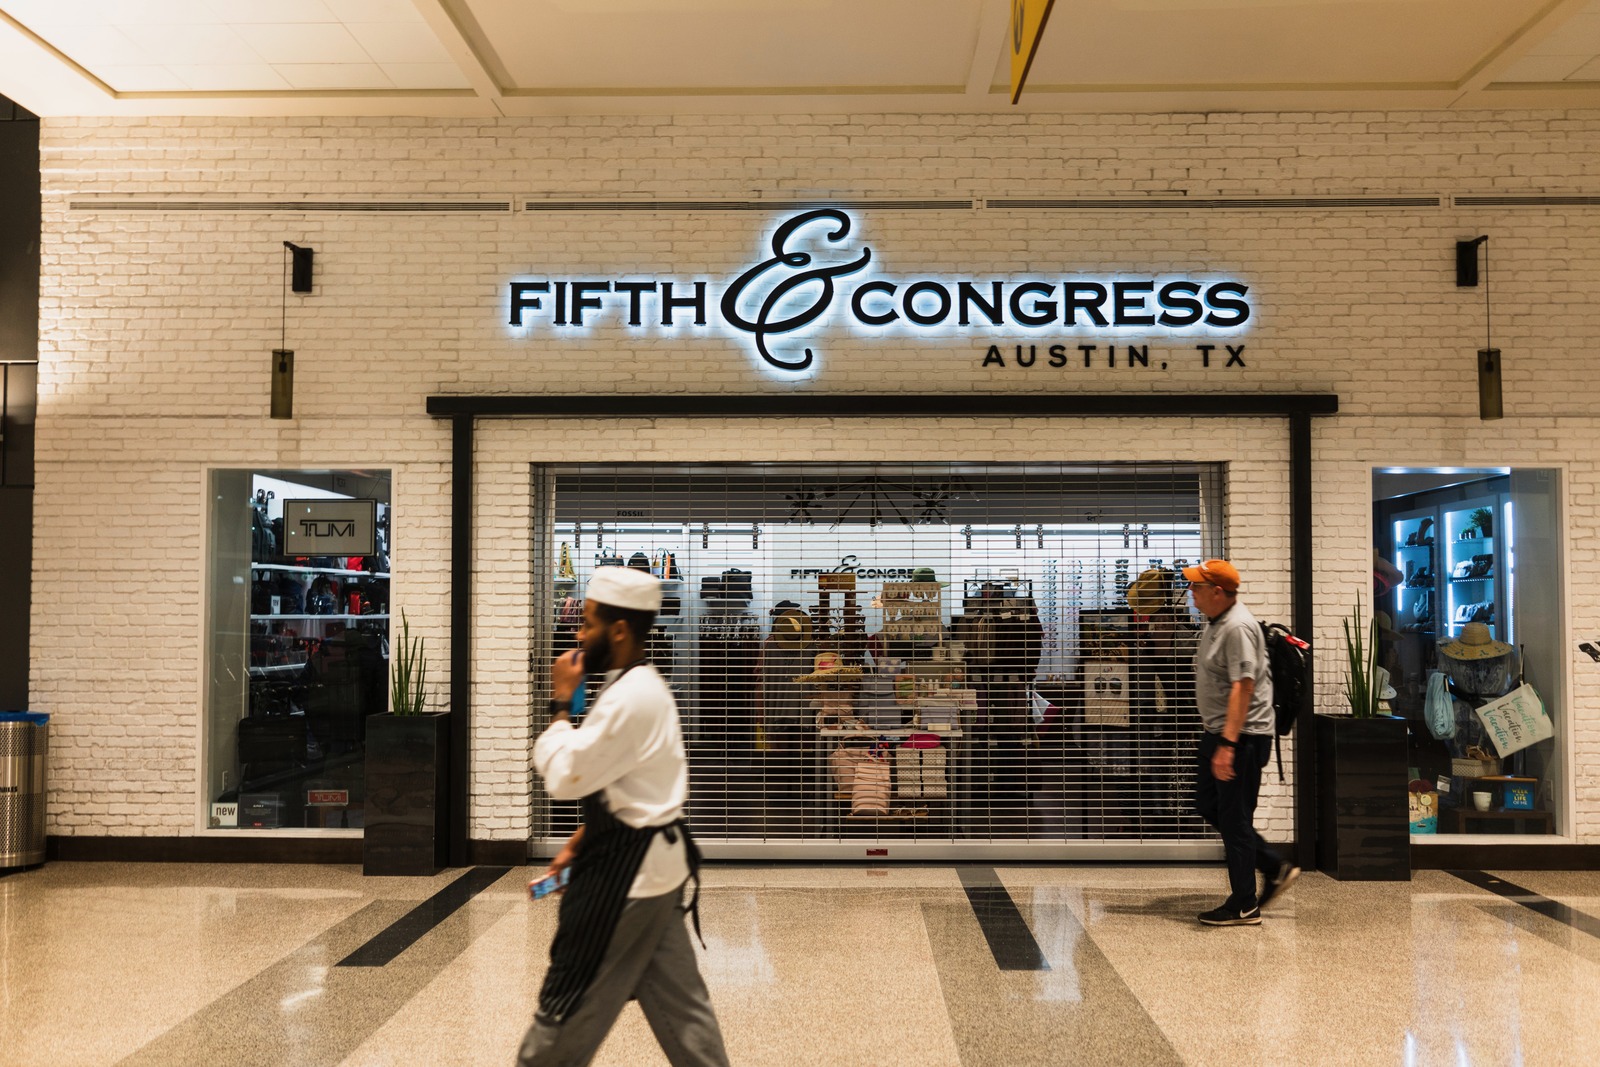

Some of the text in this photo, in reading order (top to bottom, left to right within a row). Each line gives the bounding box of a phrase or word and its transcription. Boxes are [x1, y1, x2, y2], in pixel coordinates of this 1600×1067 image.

[509, 208, 1251, 371] FIFTH & CONGRESS
[982, 344, 1247, 370] AUSTIN, TX
[299, 519, 355, 537] TUMI
[857, 569, 914, 579] CONGRE
[1483, 708, 1509, 750] Vacation
[1497, 702, 1522, 743] Vacation
[215, 805, 236, 816] new
